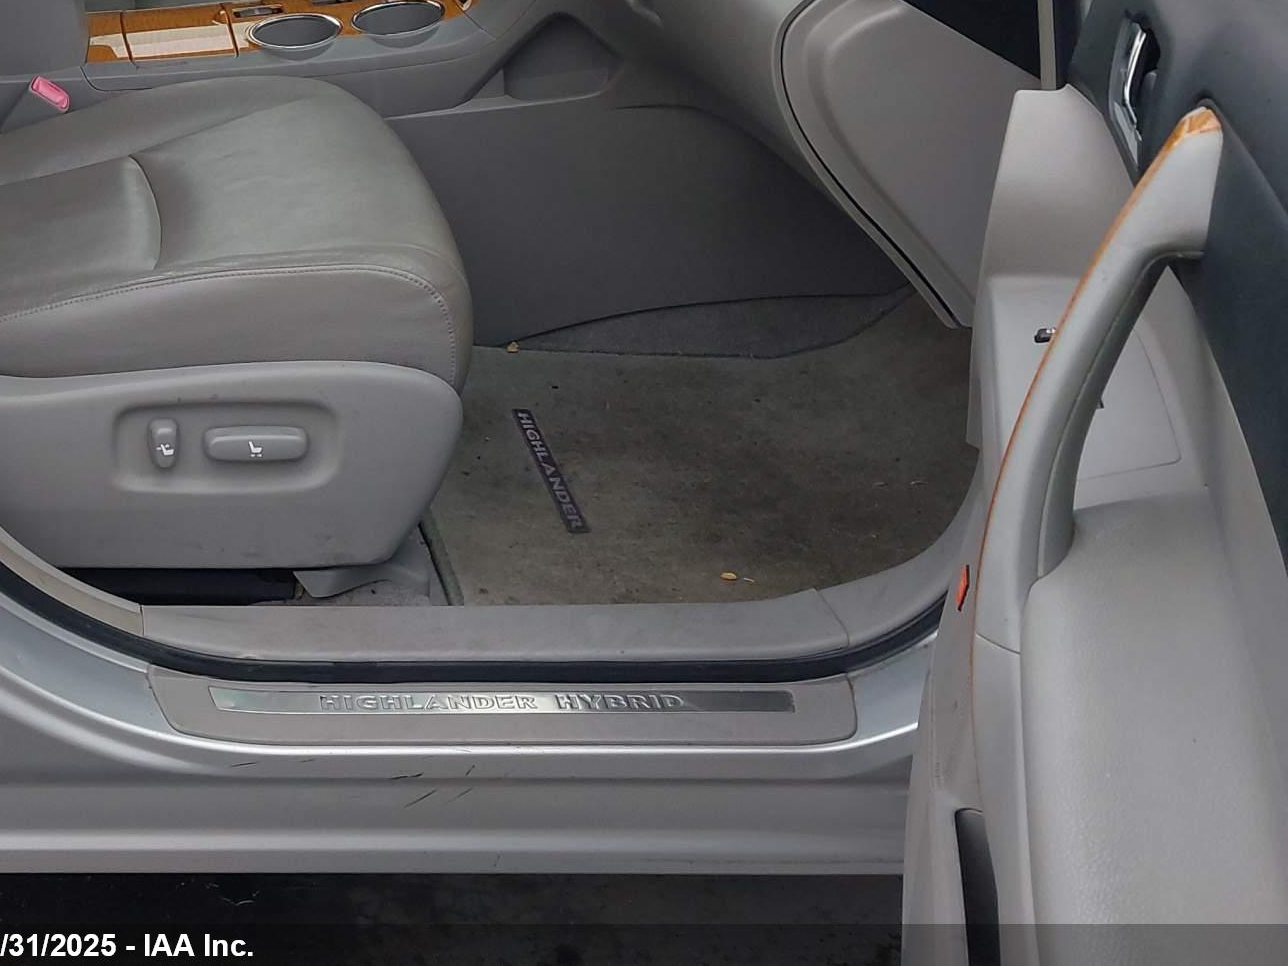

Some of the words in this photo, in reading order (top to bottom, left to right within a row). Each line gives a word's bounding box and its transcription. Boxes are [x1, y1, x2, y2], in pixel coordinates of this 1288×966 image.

[516, 411, 584, 529] HIGHLANDER
[318, 693, 538, 711] HIGHLANDER
[553, 693, 685, 711] HYBRID
